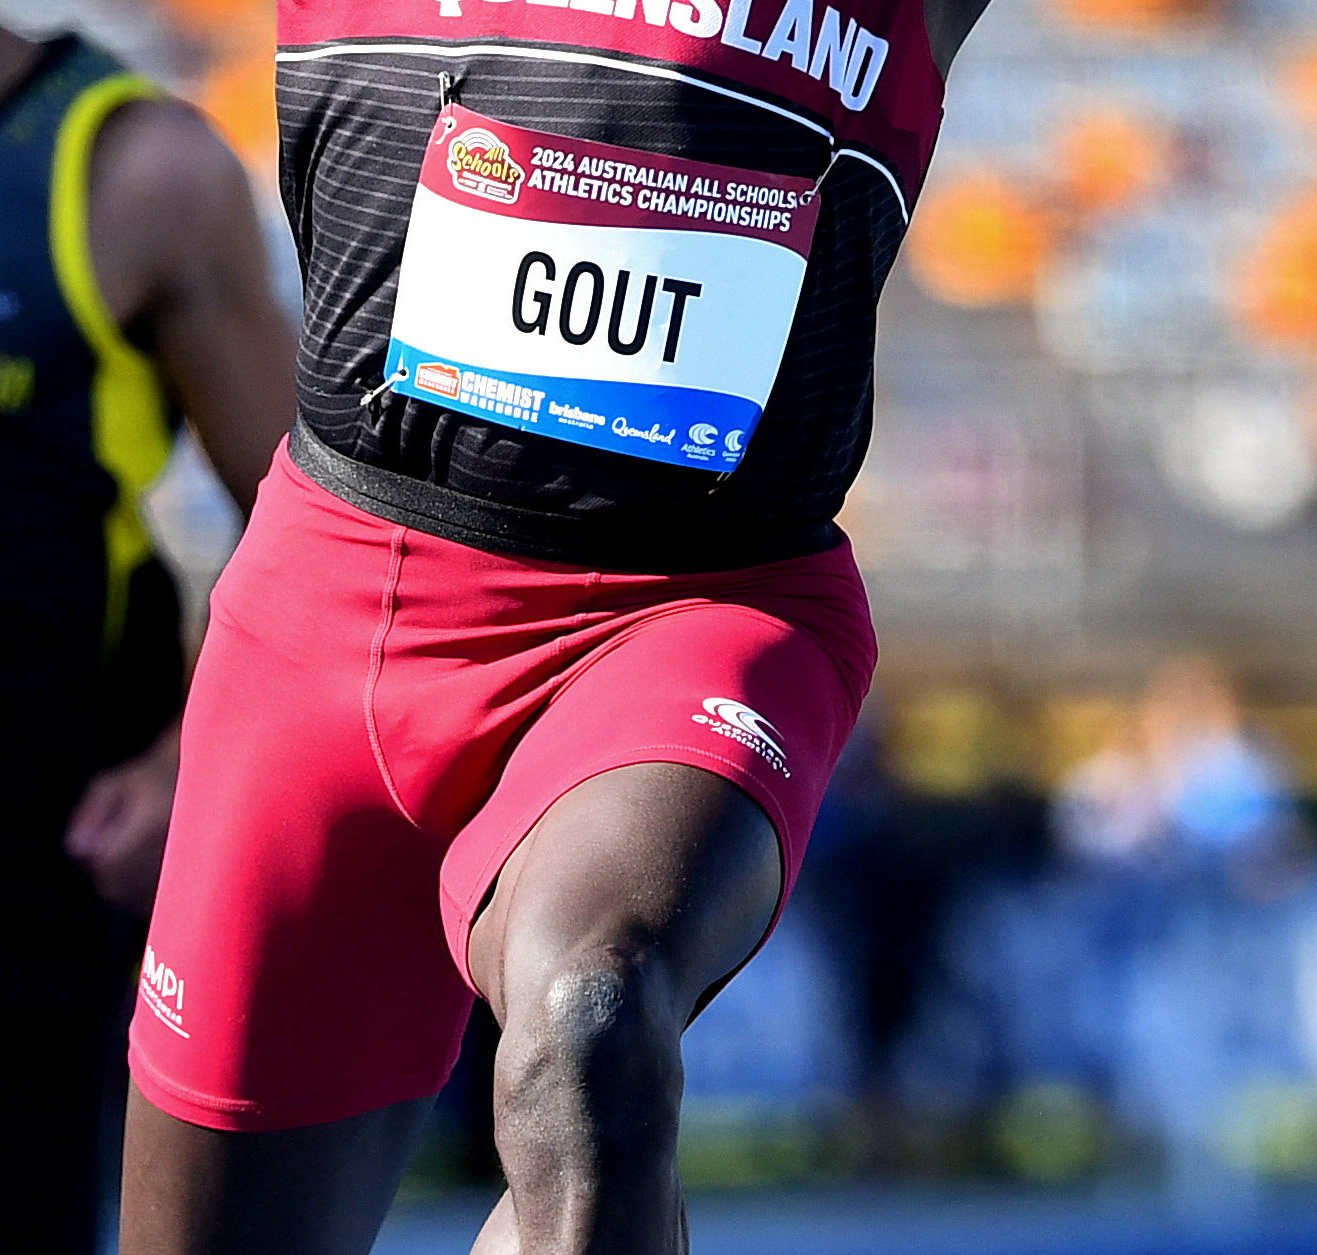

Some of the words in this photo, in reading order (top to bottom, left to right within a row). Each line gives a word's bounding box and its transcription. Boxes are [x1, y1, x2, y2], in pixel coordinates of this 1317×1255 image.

[451, 141, 520, 183] Schools
[484, 146, 504, 161] All
[531, 147, 575, 172] 2024
[577, 156, 688, 192] AUSTRALIAN
[690, 177, 721, 199] ALL
[725, 182, 797, 209] SCHOOLS
[527, 169, 634, 207] ATHLETICS
[637, 190, 792, 232] CHAMPIONSHIPS
[512, 251, 702, 363] GOUT
[461, 371, 545, 411] CHEMIST
